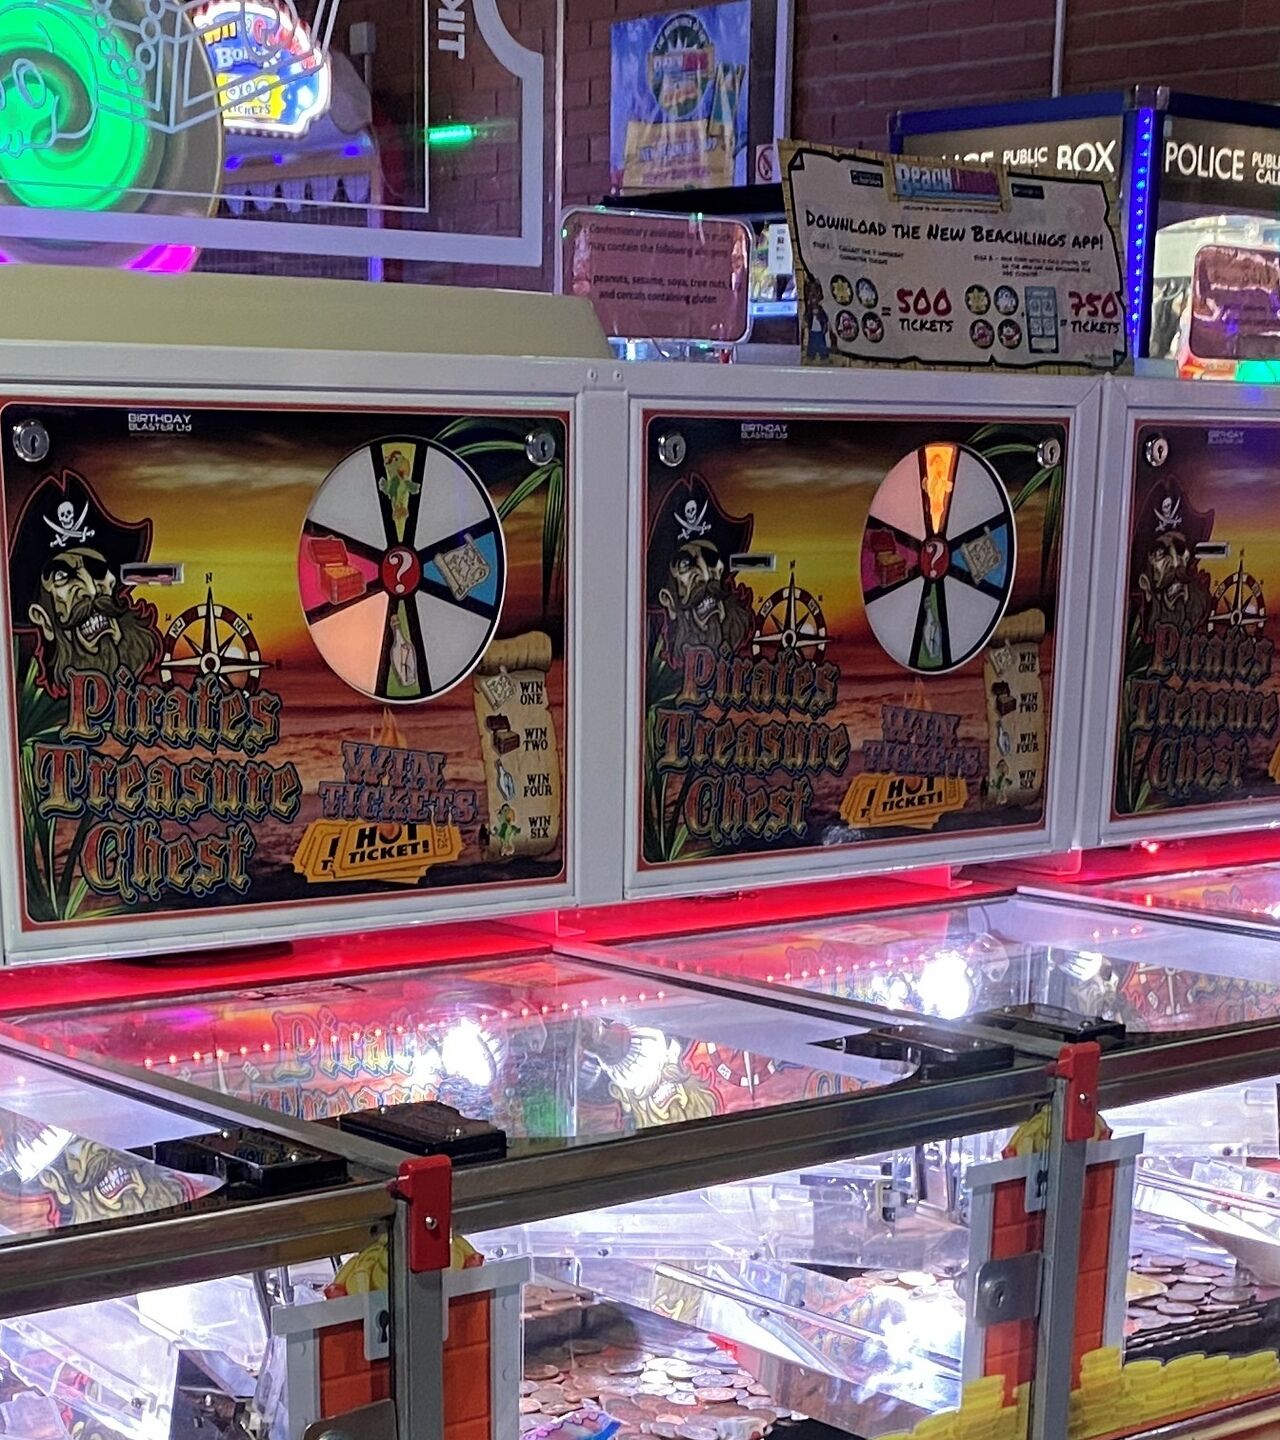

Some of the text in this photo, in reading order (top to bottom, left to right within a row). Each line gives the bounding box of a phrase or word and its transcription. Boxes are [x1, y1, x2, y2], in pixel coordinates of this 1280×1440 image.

[1003, 147, 1048, 166] PUBLIC
[1057, 140, 1116, 173] BOX
[1165, 141, 1245, 181] POLICE
[806, 210, 1104, 250] DOWNLOAD THE NEW BEACHLINGS APP!
[599, 289, 615, 299] and
[896, 287, 953, 317] 500
[1068, 290, 1119, 319] 750
[900, 318, 953, 332] TICKETS
[1070, 319, 1120, 334] TICKETS
[128, 412, 191, 425] BIRTHDAY
[128, 423, 192, 433] BLASTER Ltd
[1147, 619, 1274, 689] Pirates
[520, 681, 543, 693] WIN
[675, 642, 842, 719] Pirates
[60, 666, 283, 758] Pirates
[520, 693, 543, 705] ONE
[1130, 678, 1280, 738] Treasure
[525, 727, 548, 739] WIN
[881, 704, 960, 746] WIN
[523, 738, 548, 751] TWO
[656, 709, 852, 776] Treasure
[341, 741, 449, 791] WIN
[863, 740, 983, 777] TICKETS
[1146, 734, 1249, 798] Chest
[33, 743, 302, 822] Treasure
[523, 784, 552, 797] FOUR
[526, 773, 550, 785] WIN
[320, 782, 479, 824] TICKETS
[684, 774, 813, 846] Chest
[528, 816, 551, 828] WIN
[530, 827, 549, 839] SIX
[81, 817, 253, 903] Chest
[348, 839, 430, 864] TICKET!
